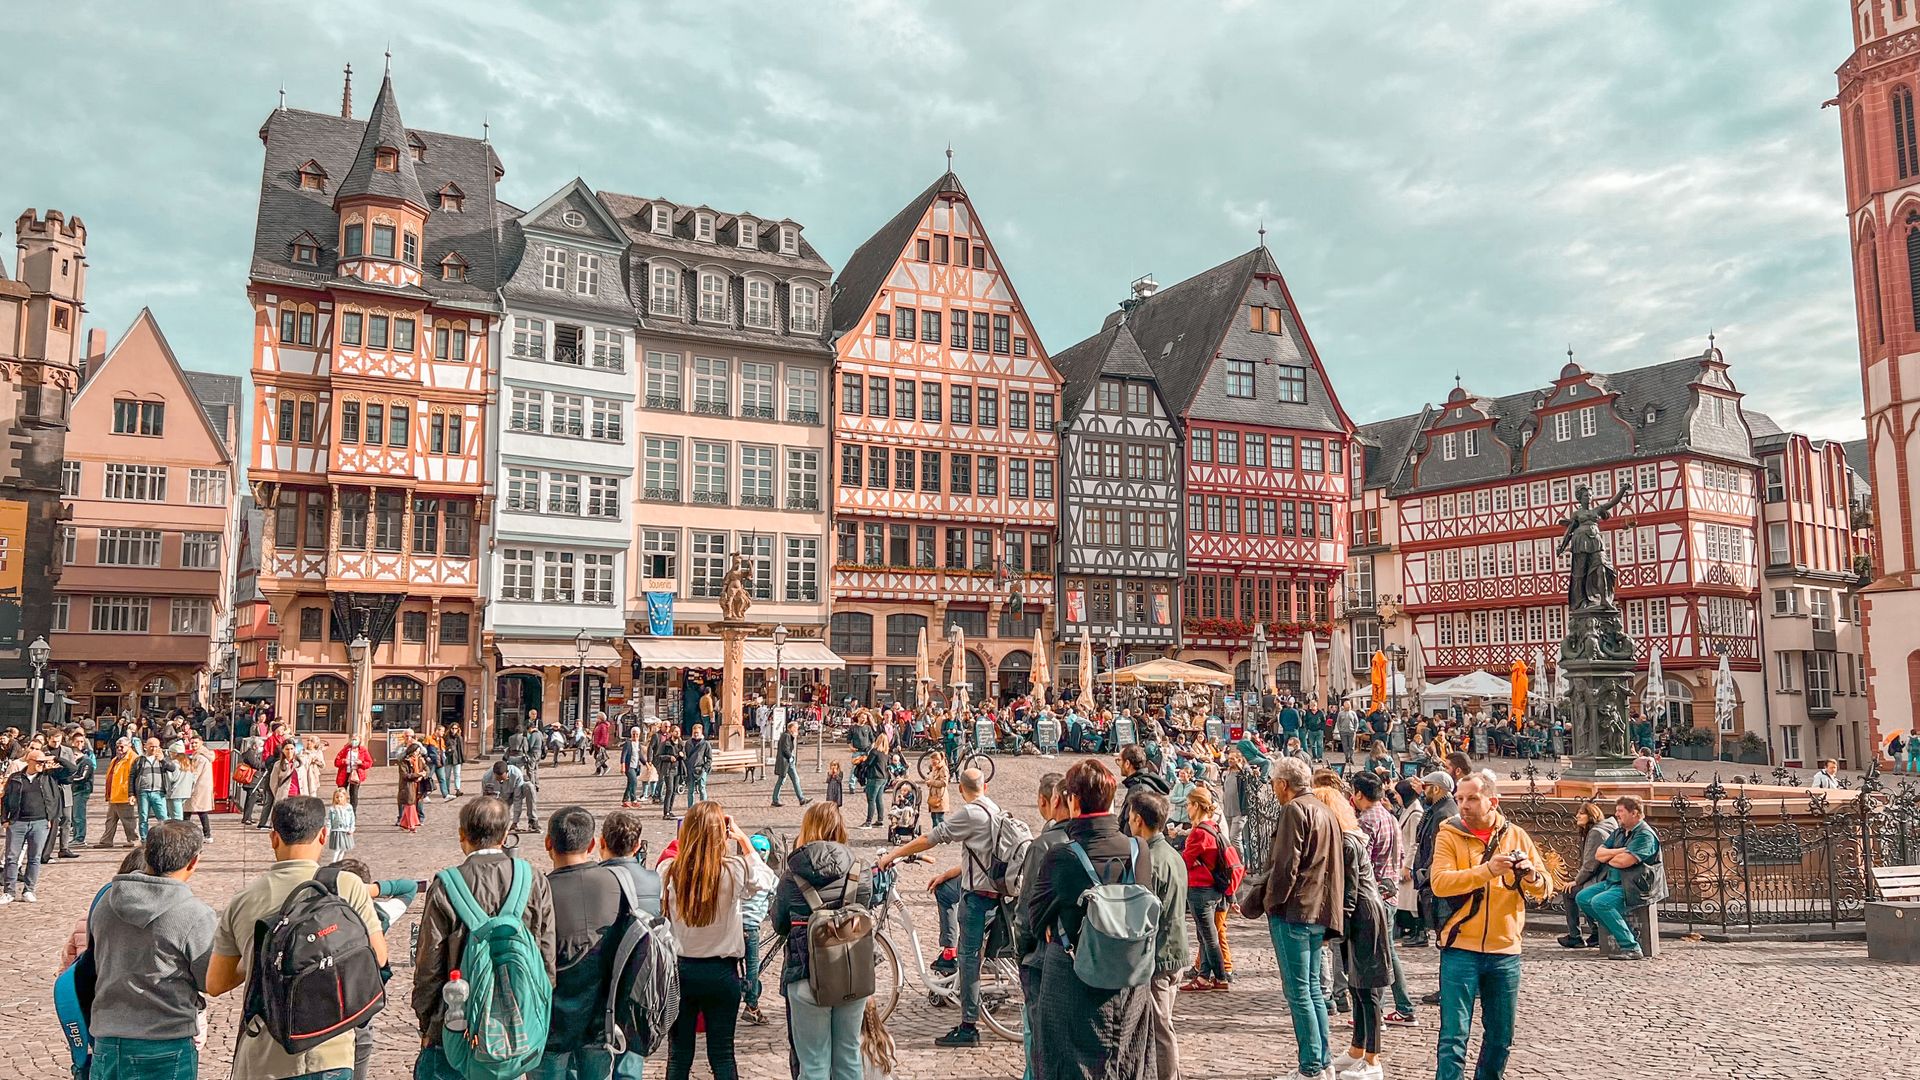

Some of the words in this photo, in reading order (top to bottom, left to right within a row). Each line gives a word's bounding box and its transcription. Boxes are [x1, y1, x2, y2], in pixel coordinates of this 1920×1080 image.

[633, 622, 701, 635] Sonirs
[298, 691, 345, 700] KAFFEE
[318, 924, 338, 937] BOSCH
